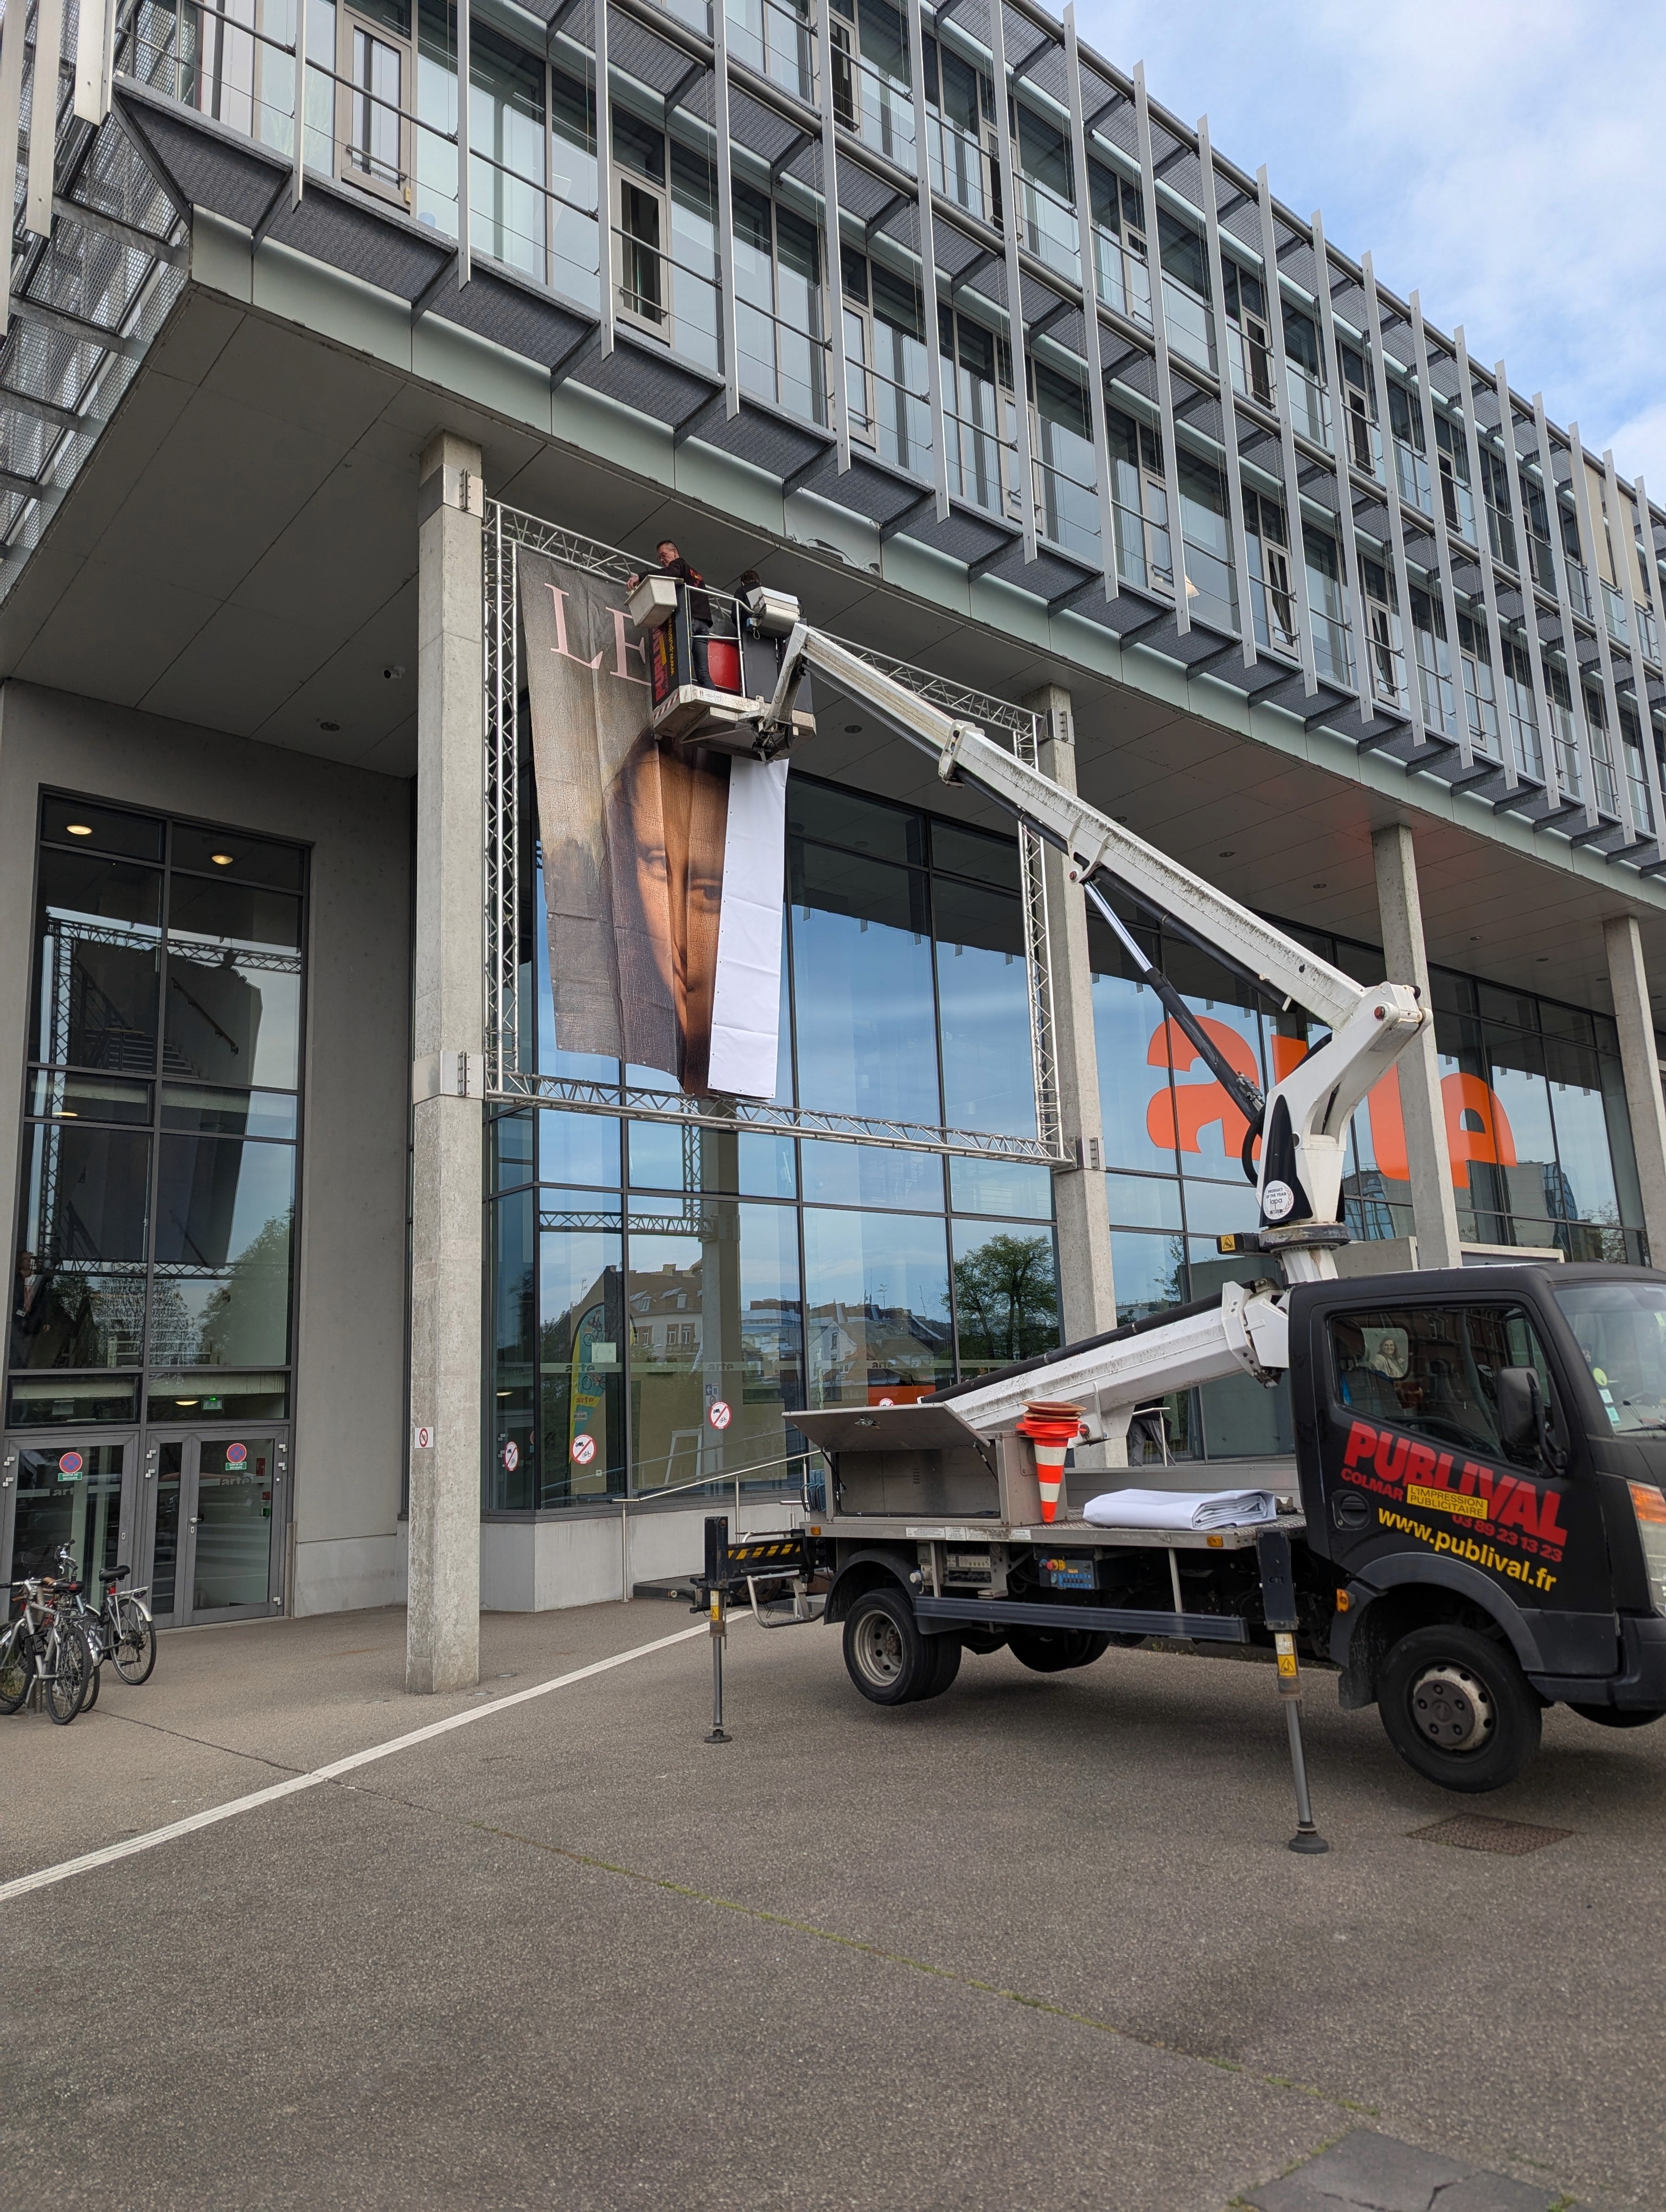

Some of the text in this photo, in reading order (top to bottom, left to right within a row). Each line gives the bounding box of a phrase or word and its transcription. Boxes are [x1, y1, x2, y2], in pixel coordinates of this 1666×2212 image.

[565, 1364, 595, 1372] arte
[708, 1362, 734, 1371] arte
[53, 1487, 75, 1496] art
[221, 1477, 250, 1486] arte
[1341, 1468, 1405, 1502] COLMAR
[1344, 1420, 1568, 1547] PUBLIVAL
[1410, 1487, 1484, 1509] L'IMPRESSION
[1410, 1496, 1484, 1517] PUBLICITAIRE
[1378, 1507, 1557, 1592] www.publival.fr
[1473, 1519, 1495, 1537] 89
[1497, 1528, 1518, 1546] 23
[1520, 1538, 1538, 1553] 13
[1539, 1543, 1563, 1563] 23
